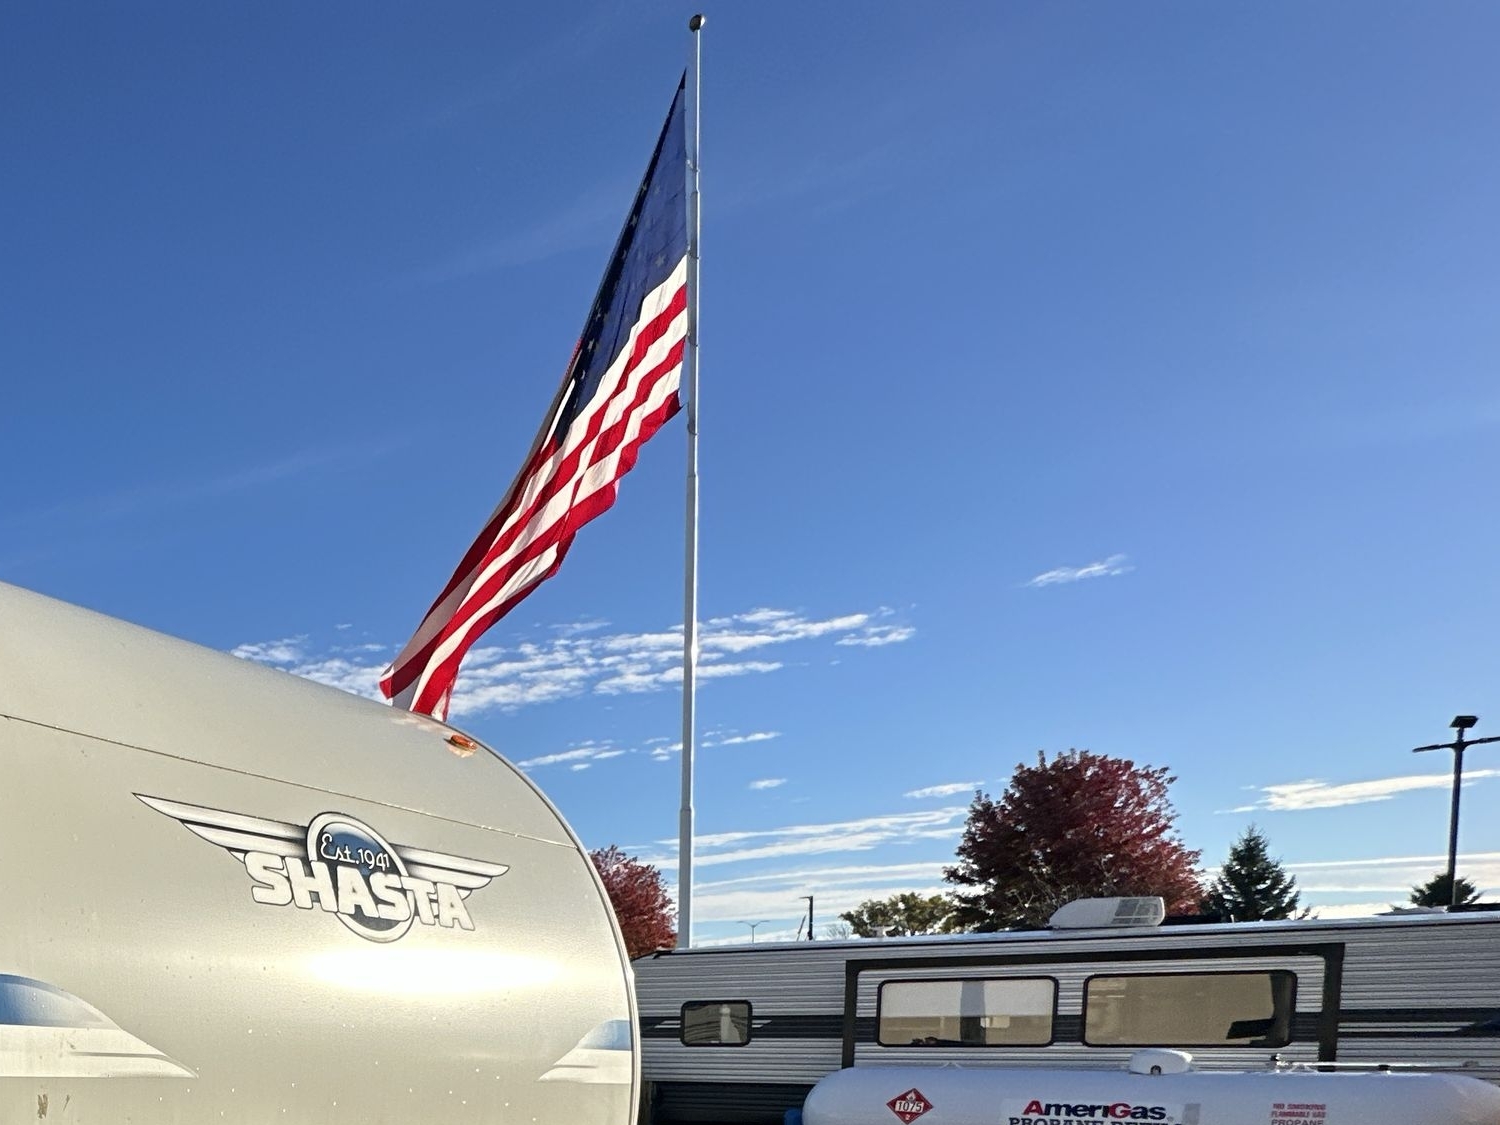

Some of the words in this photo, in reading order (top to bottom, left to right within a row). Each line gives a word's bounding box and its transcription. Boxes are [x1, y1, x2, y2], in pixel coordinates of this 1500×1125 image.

[320, 833, 360, 865] Est.
[358, 849, 391, 871] 1941
[243, 850, 476, 931] SHASTA
[898, 1101, 922, 1112] 1075
[1023, 1100, 1167, 1121] AmeriGas
